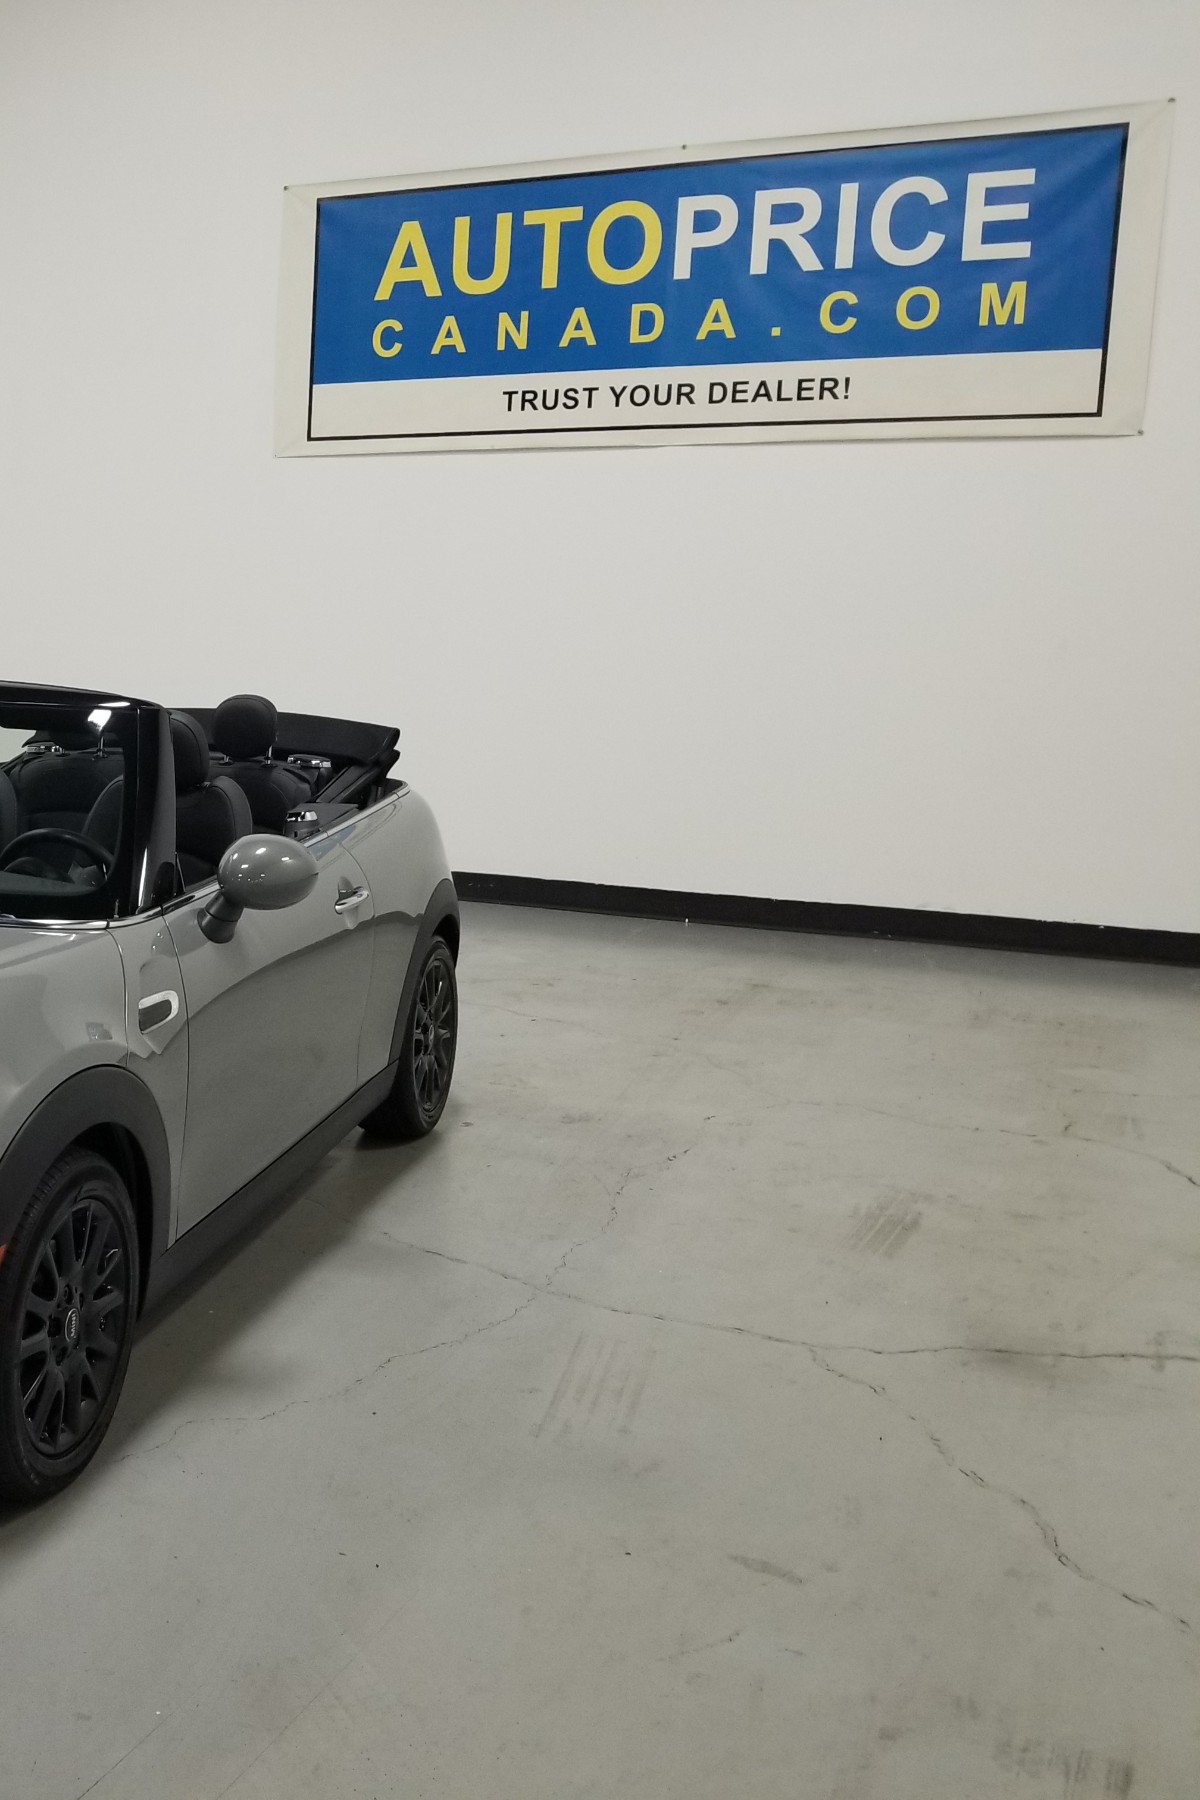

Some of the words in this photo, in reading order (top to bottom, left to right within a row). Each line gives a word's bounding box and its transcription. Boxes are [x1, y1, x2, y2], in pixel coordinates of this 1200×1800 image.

[374, 168, 1036, 301] AUTOPRICE
[372, 280, 1027, 358] CANADA.COM
[502, 386, 599, 412] TRUST
[609, 383, 696, 408] YOUR
[708, 376, 851, 405] DEALER!
